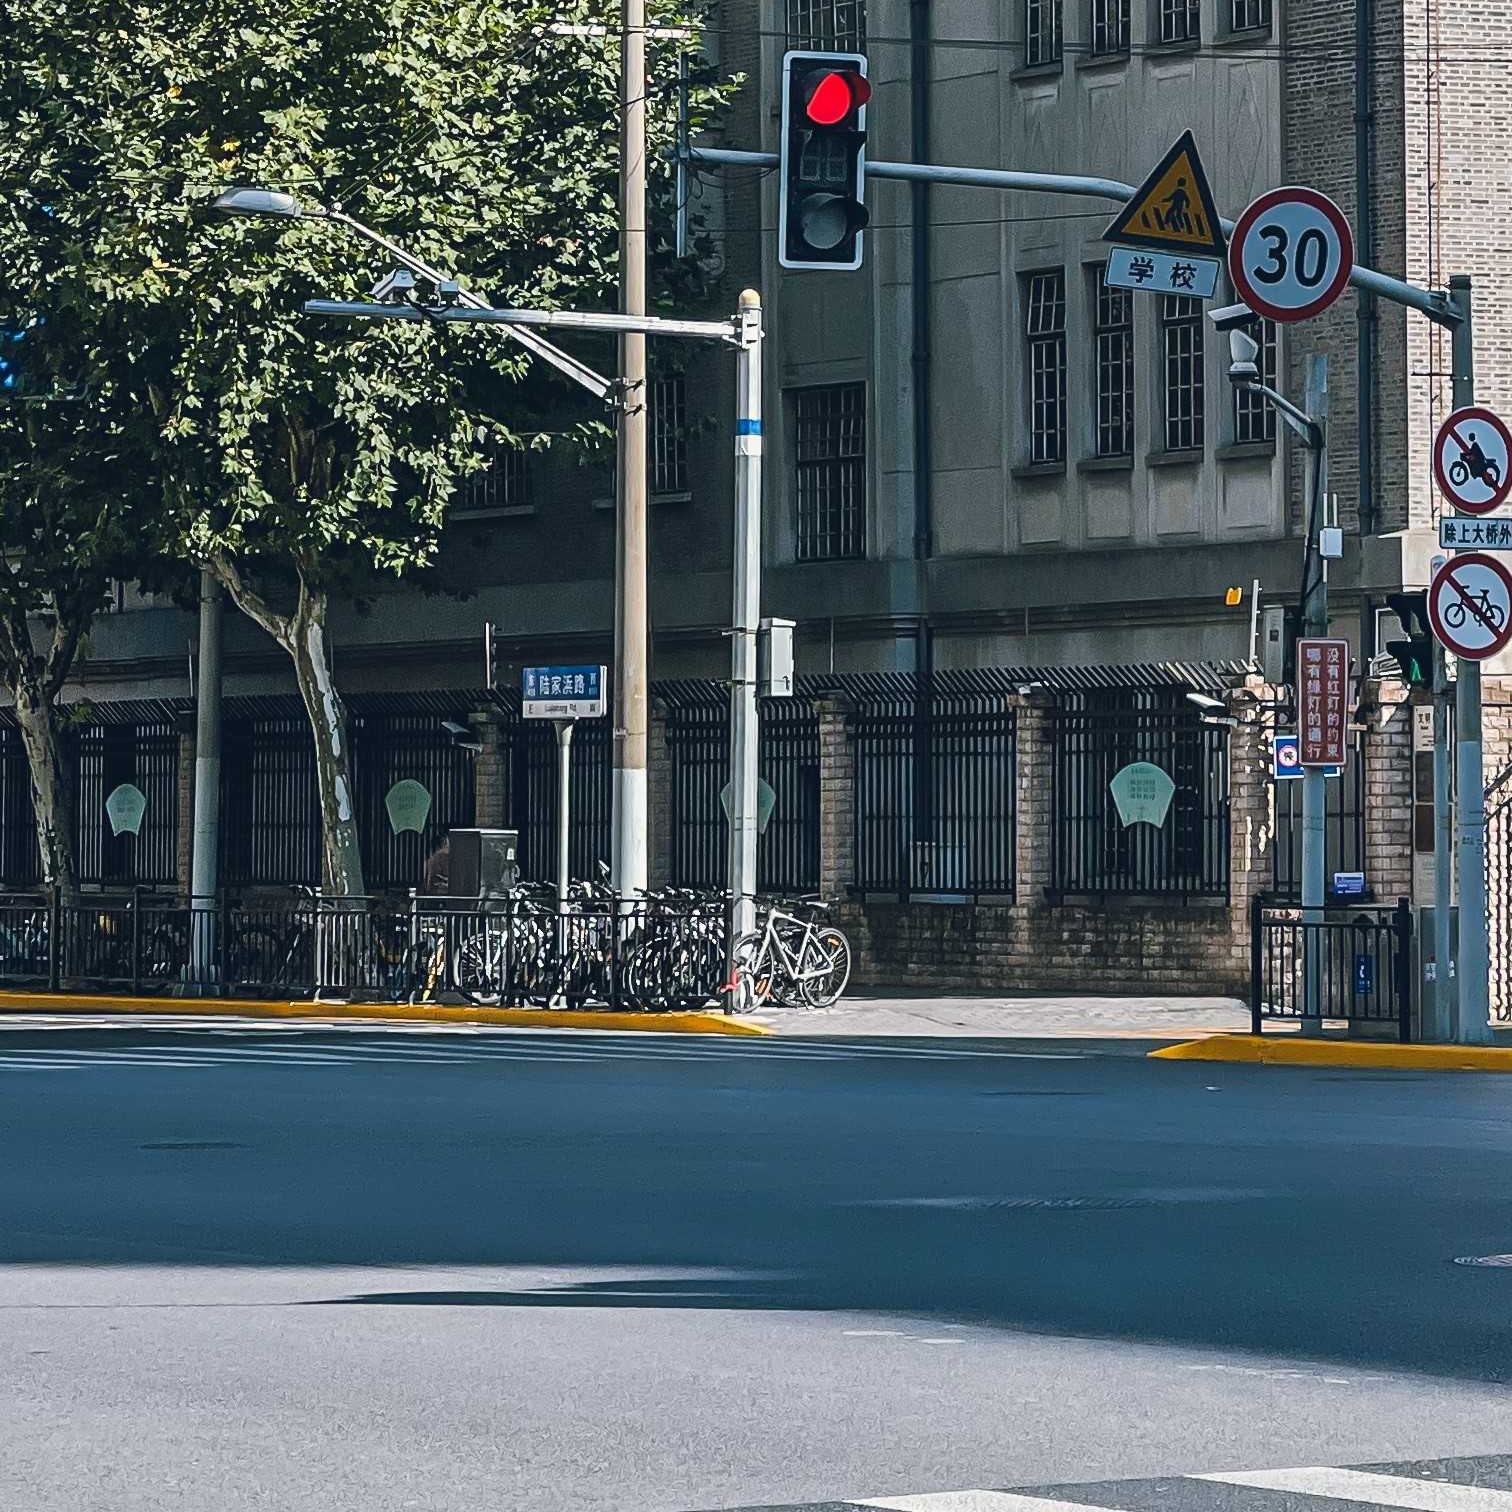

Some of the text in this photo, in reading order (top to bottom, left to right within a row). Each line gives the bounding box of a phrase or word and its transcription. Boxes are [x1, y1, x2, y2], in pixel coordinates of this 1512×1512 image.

[1253, 224, 1329, 287] 30
[1128, 255, 1197, 289] 学校
[1445, 522, 1511, 544] 除上大桥外
[539, 674, 585, 696] 陆家浜路
